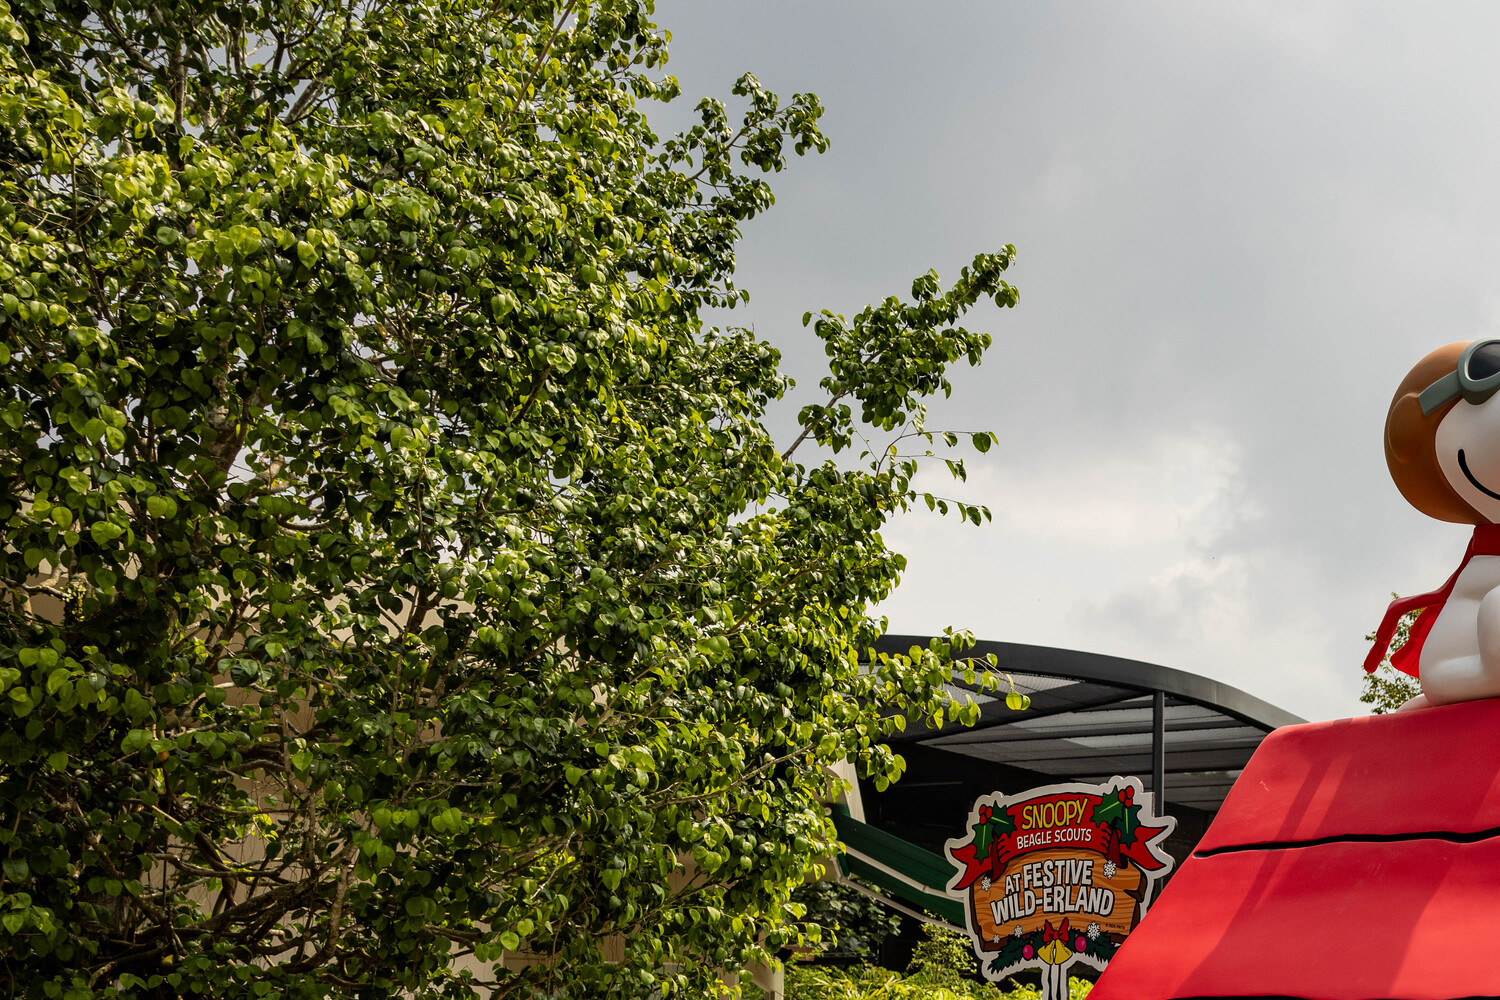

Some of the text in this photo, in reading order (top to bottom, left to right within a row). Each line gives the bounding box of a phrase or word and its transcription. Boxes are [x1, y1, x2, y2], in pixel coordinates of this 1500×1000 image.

[1021, 797, 1089, 830] SNOOPY
[1016, 828, 1092, 850] BEAGLE SCOUTS
[1005, 859, 1094, 896] AT FESTIVE
[990, 885, 1115, 925] WILD-ERLAND
